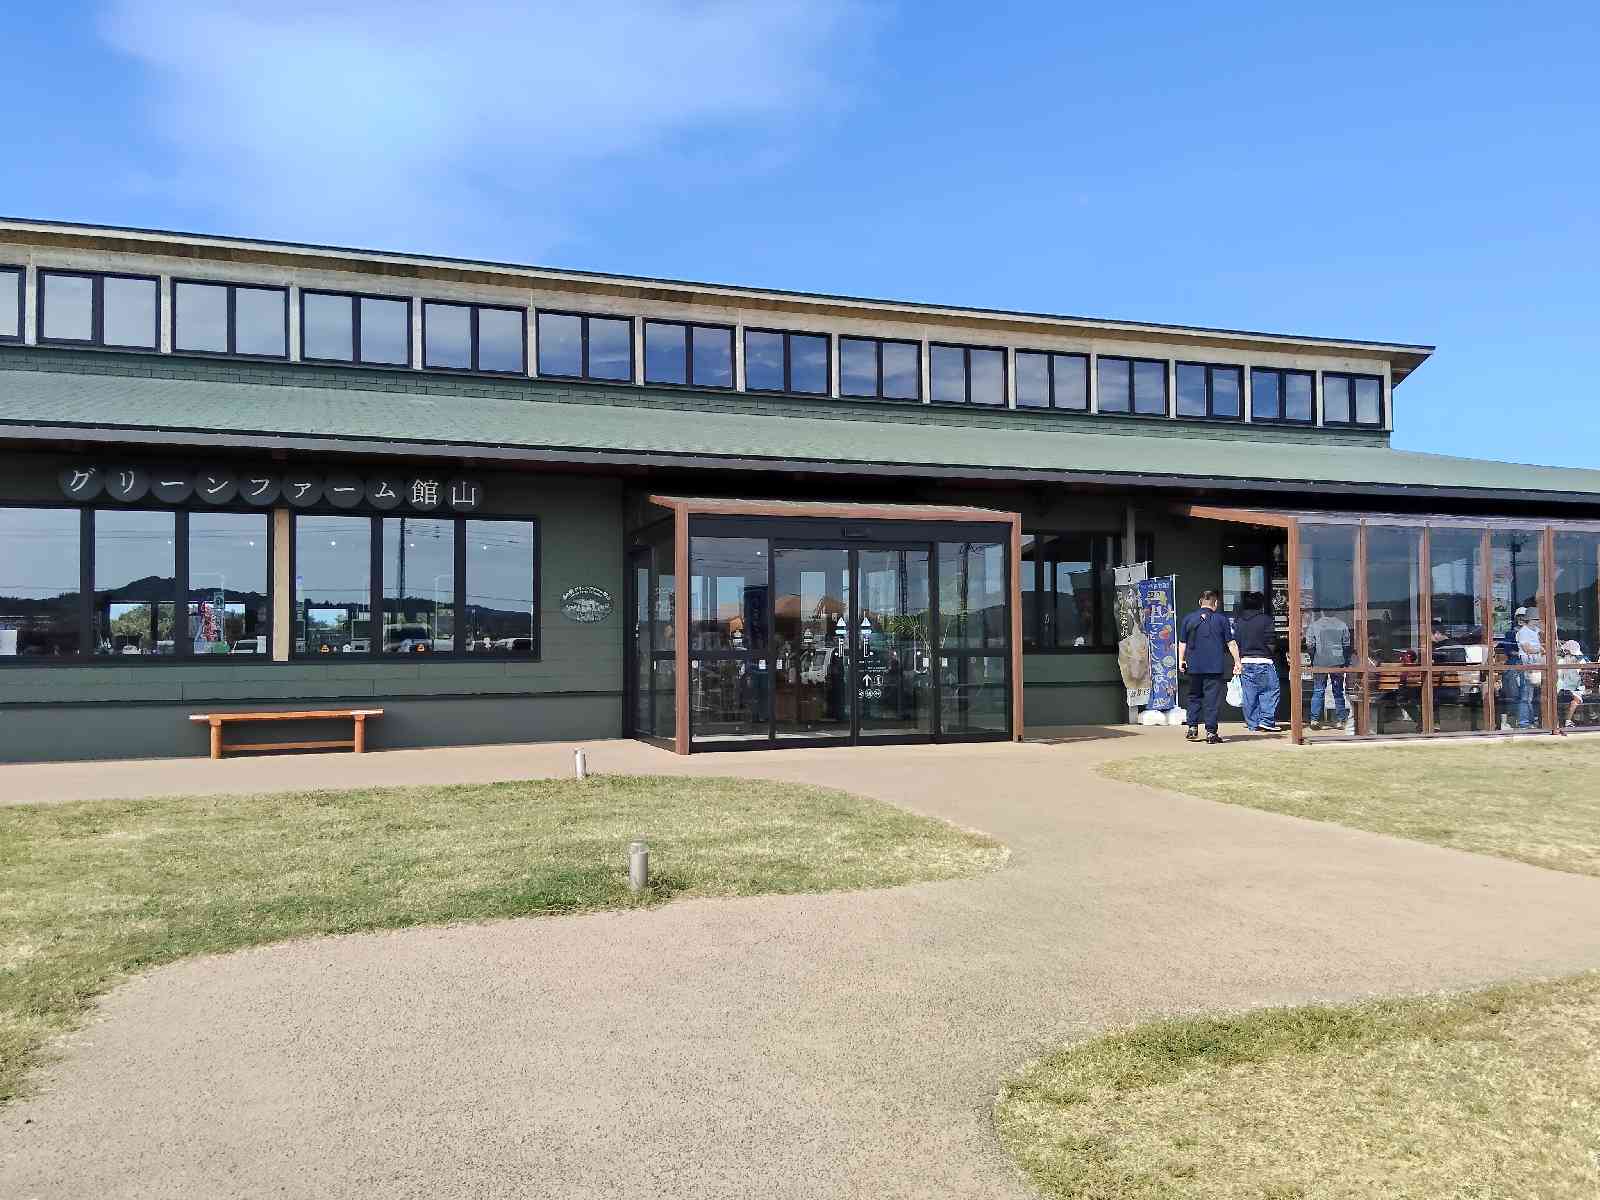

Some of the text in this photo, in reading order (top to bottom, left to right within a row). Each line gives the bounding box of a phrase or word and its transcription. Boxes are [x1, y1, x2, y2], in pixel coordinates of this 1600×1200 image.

[70, 468, 476, 506] グリーンファーム館山
